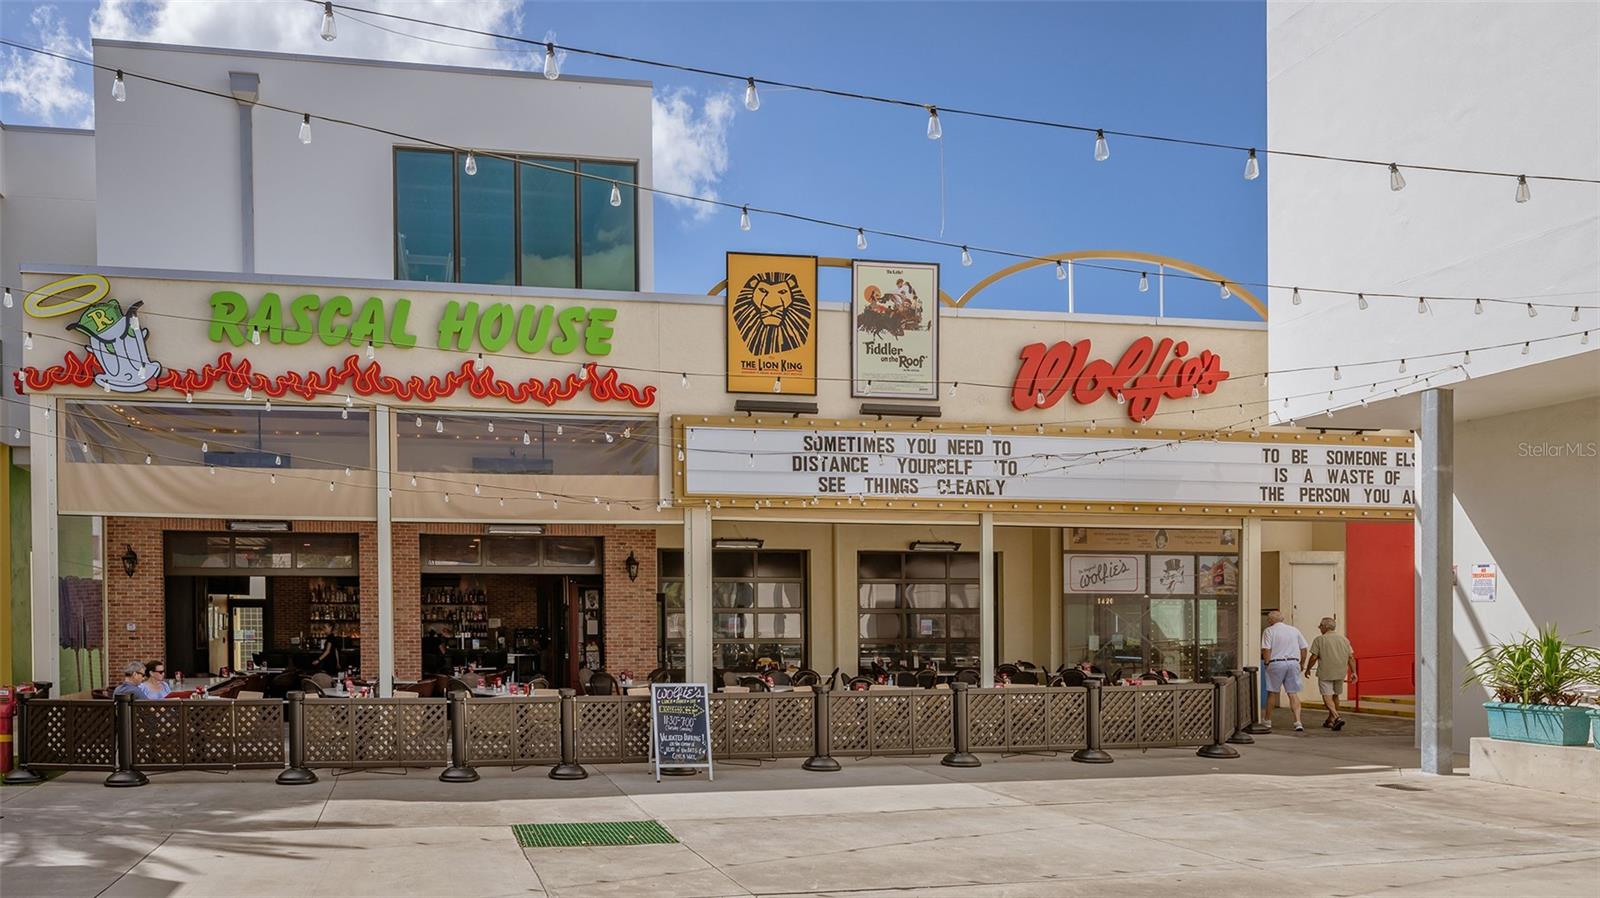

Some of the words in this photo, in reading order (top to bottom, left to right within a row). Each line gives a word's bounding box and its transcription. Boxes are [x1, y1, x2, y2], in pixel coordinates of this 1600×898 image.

[208, 290, 418, 350] RASCAL
[438, 300, 618, 356] HOUSE
[758, 359, 779, 371] LION
[781, 359, 803, 372] KING
[1011, 336, 1230, 423] Wolfie's
[803, 435, 895, 453] SOMETIMES
[906, 438, 937, 454] YOU
[948, 439, 984, 455] NEED
[993, 440, 1011, 456] TO
[792, 456, 869, 472] DISTANCE
[897, 458, 973, 474] YOURSELF
[1000, 460, 1018, 476] TO
[1262, 448, 1280, 464] TO
[1292, 449, 1308, 464] BE
[1326, 450, 1387, 466] SOMEONE
[1274, 467, 1288, 483] IS
[1304, 468, 1313, 483] A
[1327, 469, 1374, 485] WASTE
[1385, 470, 1401, 485] OF
[818, 477, 846, 493] SEE
[864, 477, 919, 494] THINGS
[937, 479, 1006, 495] CLEARLY
[1260, 486, 1285, 502] THE
[1300, 487, 1350, 503] PERSON
[1364, 488, 1390, 503] YOU
